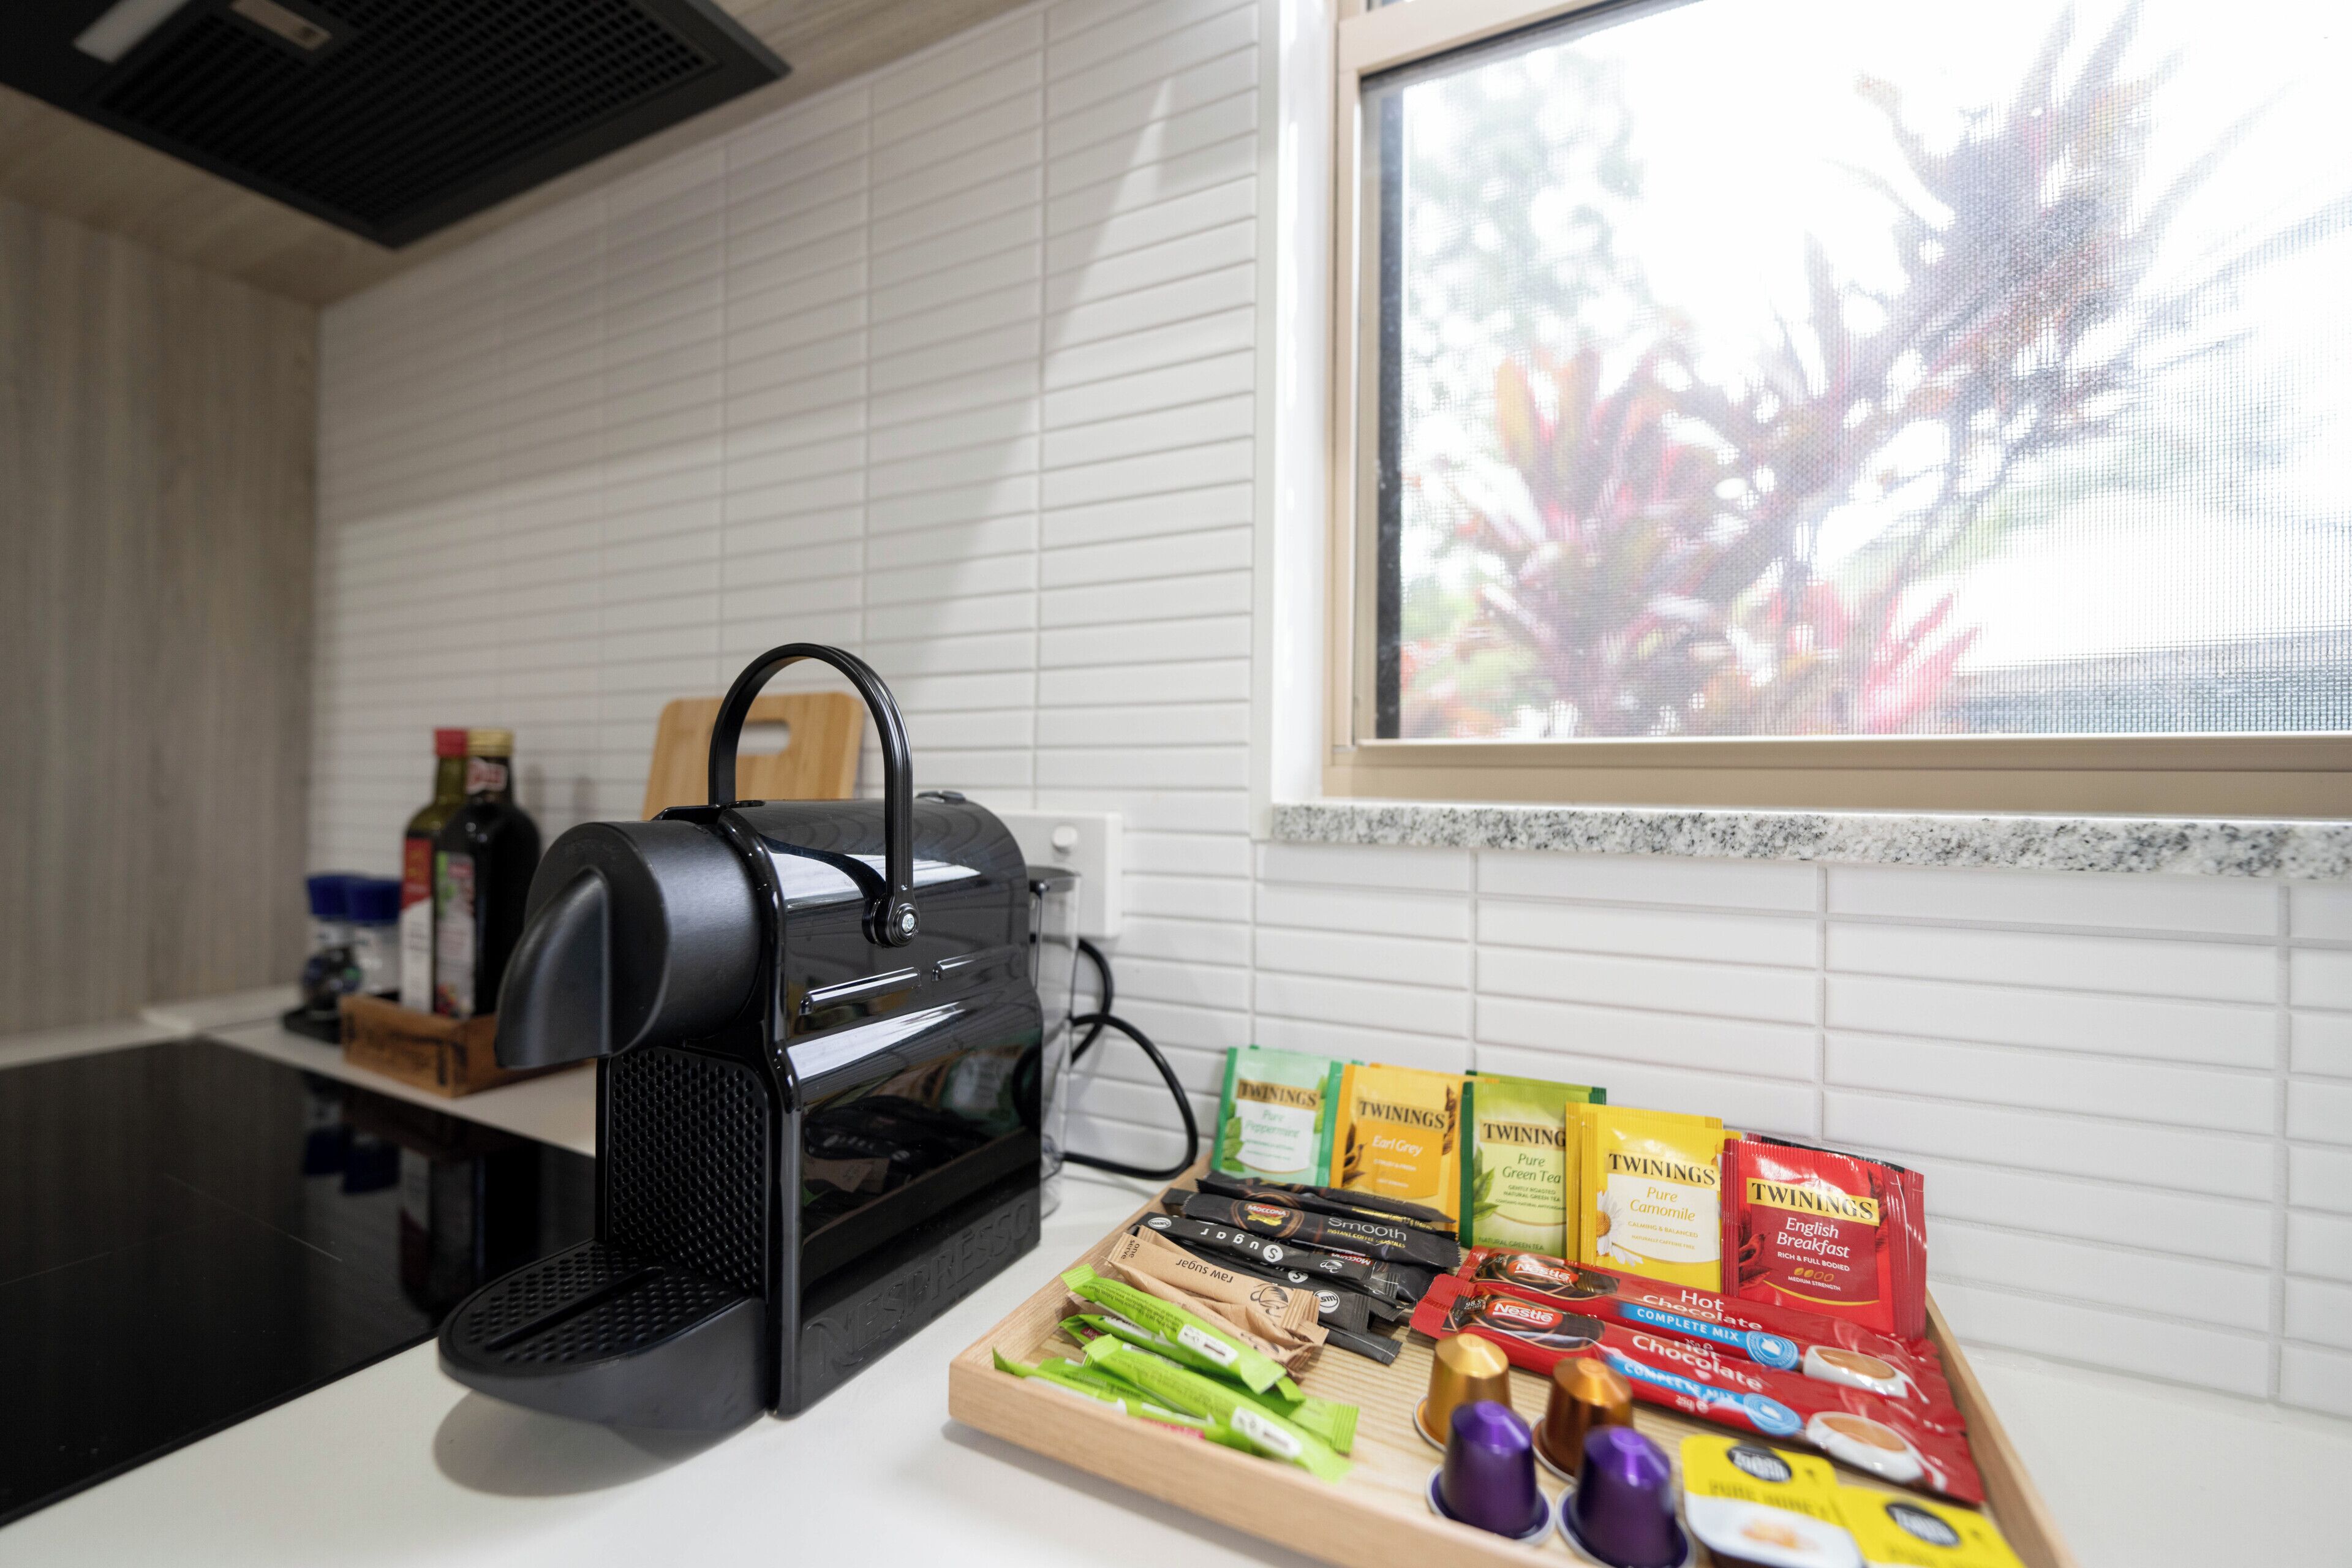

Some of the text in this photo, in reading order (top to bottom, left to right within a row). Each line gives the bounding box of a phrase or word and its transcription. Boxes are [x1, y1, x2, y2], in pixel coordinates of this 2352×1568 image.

[1240, 1082, 1317, 1107] TWININGS
[1360, 1101, 1446, 1129] TWININGS
[1371, 1134, 1423, 1157] Earl Grey
[1517, 1152, 1546, 1167] Pure
[1608, 1153, 1716, 1186] TWININGS
[1502, 1166, 1562, 1185] Green Tea
[1646, 1186, 1678, 1202] Pure
[1751, 1182, 1874, 1220] TWININGS
[1630, 1199, 1696, 1222] Camomile
[1328, 1217, 1407, 1242] Smooth
[1627, 1221, 1657, 1231] CALMING
[1664, 1227, 1698, 1238] BALANCED
[1785, 1216, 1839, 1239] English
[1120, 1240, 1136, 1259] serve
[1128, 1243, 1140, 1258] one
[1776, 1231, 1851, 1259] Breakfast
[1175, 1259, 1234, 1283] raw sugar
[1777, 1251, 1796, 1261] RICH
[1803, 1256, 1821, 1266] FULL
[1822, 1260, 1850, 1272] BODIED
[804, 1202, 1035, 1378] NESPRESSO
[1787, 1275, 1842, 1292] MEDIUM STRENGTH
[1492, 1302, 1554, 1323] Nestlé
[1642, 1294, 1763, 1331] Chocolate
[1681, 1289, 1725, 1313] Hot
[1637, 1308, 1740, 1342] COMPLETE MIX
[1632, 1335, 1763, 1392] Chocolate
